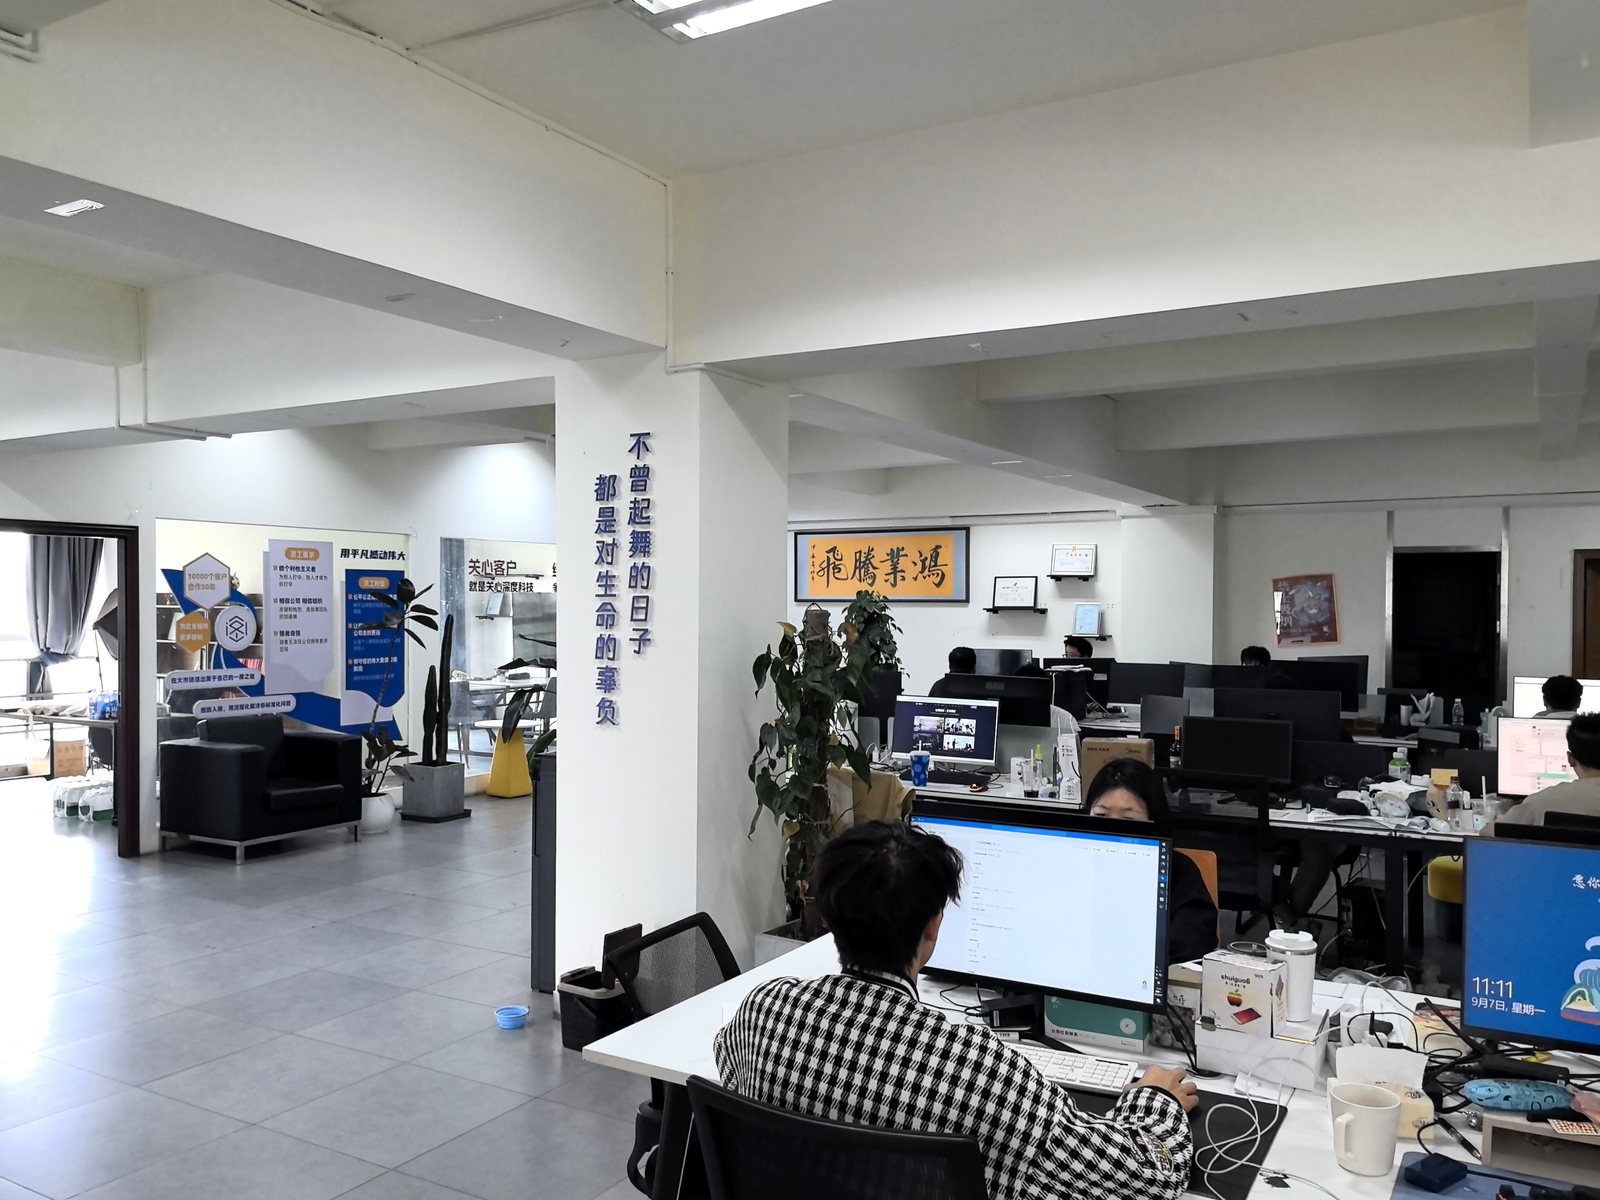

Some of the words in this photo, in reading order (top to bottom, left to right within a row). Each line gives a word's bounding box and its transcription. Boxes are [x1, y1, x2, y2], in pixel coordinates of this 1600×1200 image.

[627, 431, 652, 655] 不曾起舞的日子
[340, 548, 406, 561] 用平凡撼动伟大
[468, 559, 517, 577] 关心客户
[468, 581, 534, 593] 就是关心深度科技
[594, 473, 618, 726] 都是对生命的辜负
[1472, 976, 1513, 999] 11:11
